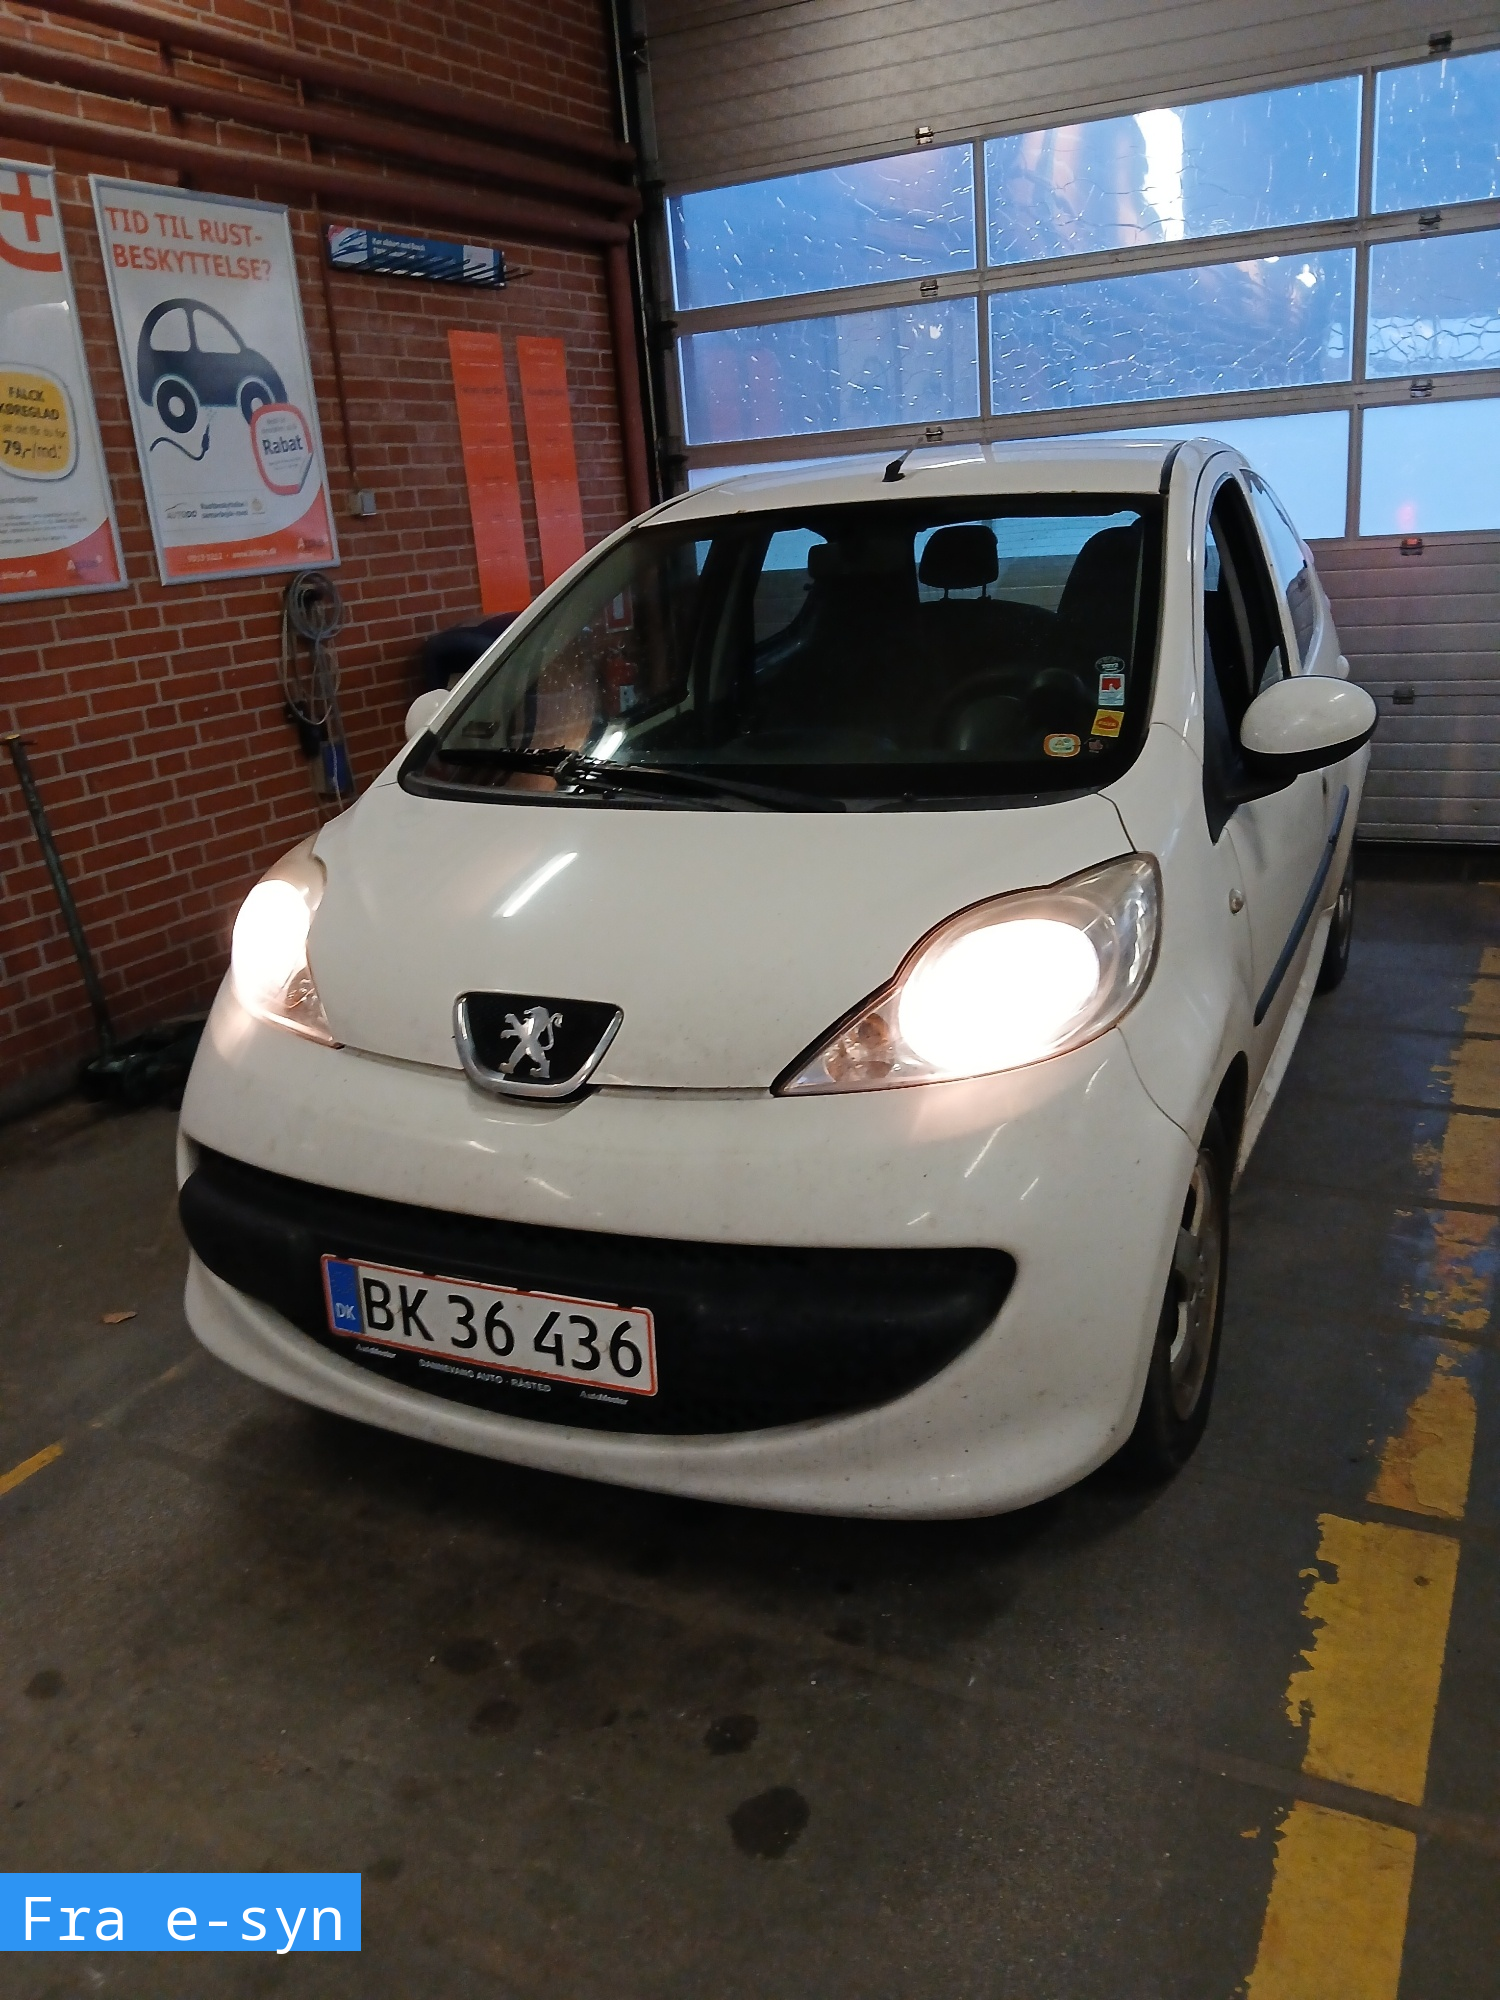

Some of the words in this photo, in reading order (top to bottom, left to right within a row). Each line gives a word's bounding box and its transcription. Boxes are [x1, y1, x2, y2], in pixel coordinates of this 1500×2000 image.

[104, 206, 149, 234] TID
[153, 212, 194, 240] TIL
[198, 218, 263, 247] RUST-
[112, 243, 272, 281] BESKYTTELSE?
[262, 435, 303, 455] Rabat
[335, 1302, 357, 1321] DK
[362, 1277, 434, 1341] BK
[448, 1294, 515, 1357] 36
[533, 1311, 643, 1378] 436
[476, 1371, 503, 1384] AUTO
